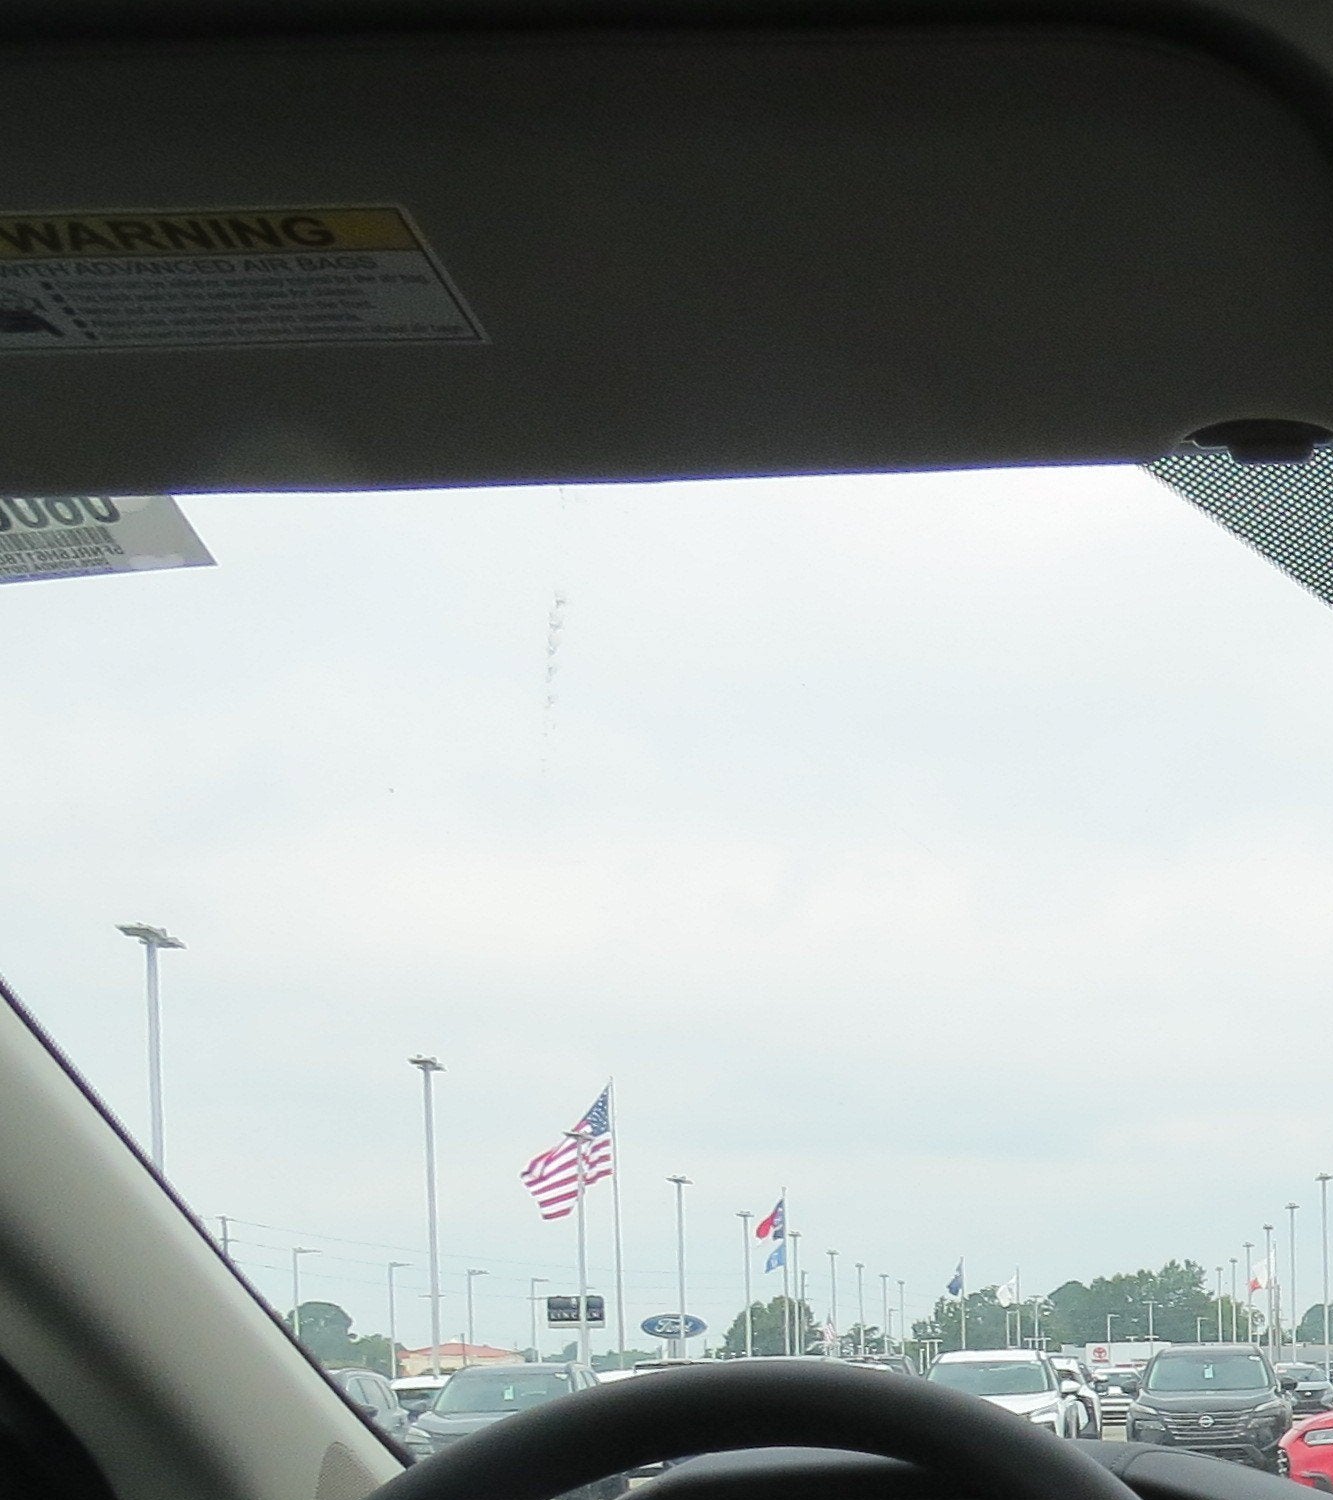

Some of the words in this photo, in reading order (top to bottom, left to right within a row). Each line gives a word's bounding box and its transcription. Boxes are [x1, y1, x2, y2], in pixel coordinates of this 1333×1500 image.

[0, 215, 336, 253] WARNING
[75, 259, 235, 277] ADVANCED
[243, 257, 288, 273] AIR
[294, 255, 378, 272] BAGS
[655, 1318, 694, 1333] Fod
